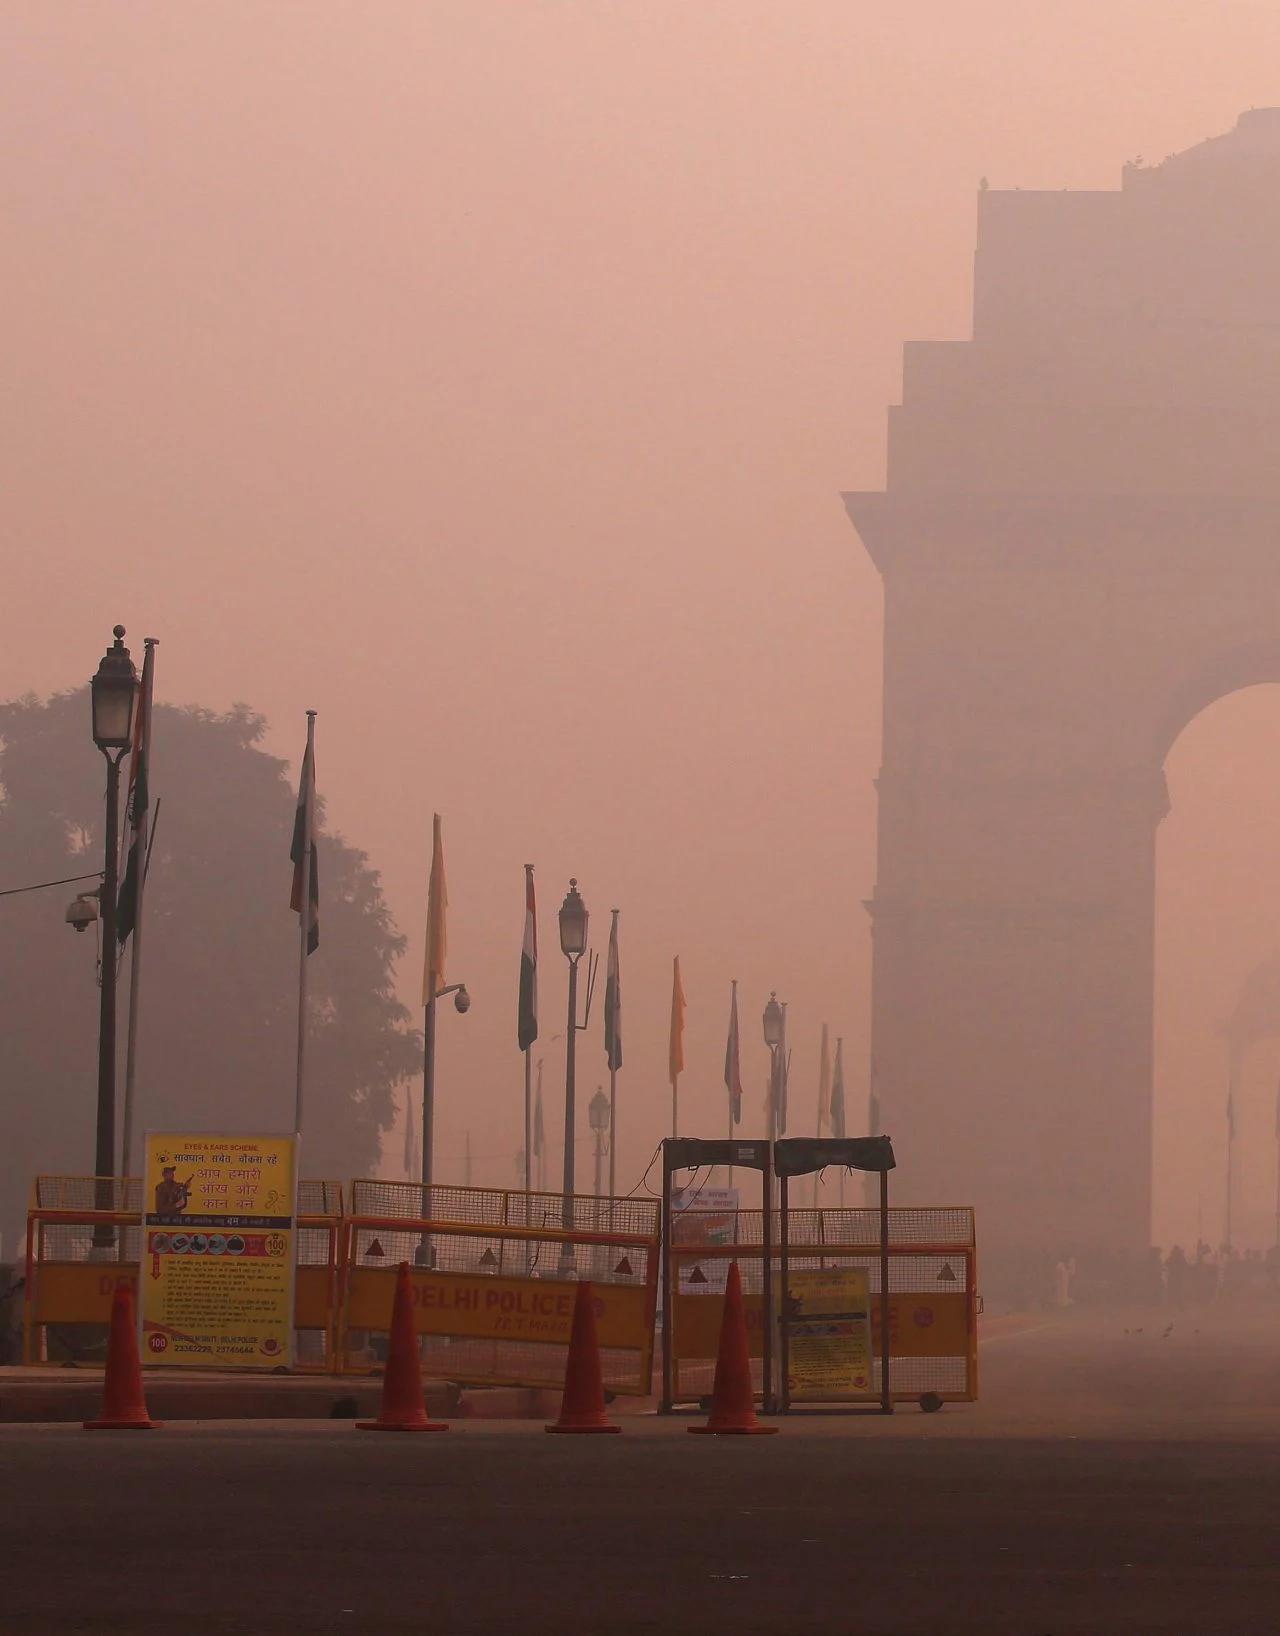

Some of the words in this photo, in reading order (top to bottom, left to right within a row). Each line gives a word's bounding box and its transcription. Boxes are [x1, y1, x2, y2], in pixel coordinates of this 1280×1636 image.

[230, 1144, 260, 1152] SCHEME
[197, 1169, 220, 1179] आप
[228, 1168, 261, 1180] हमारी
[235, 1180, 258, 1195] और
[203, 1198, 228, 1209] कान
[267, 1240, 284, 1250] 100
[411, 1284, 479, 1311] DELHI
[486, 1290, 571, 1317] POLICE
[151, 1337, 166, 1348] 100
